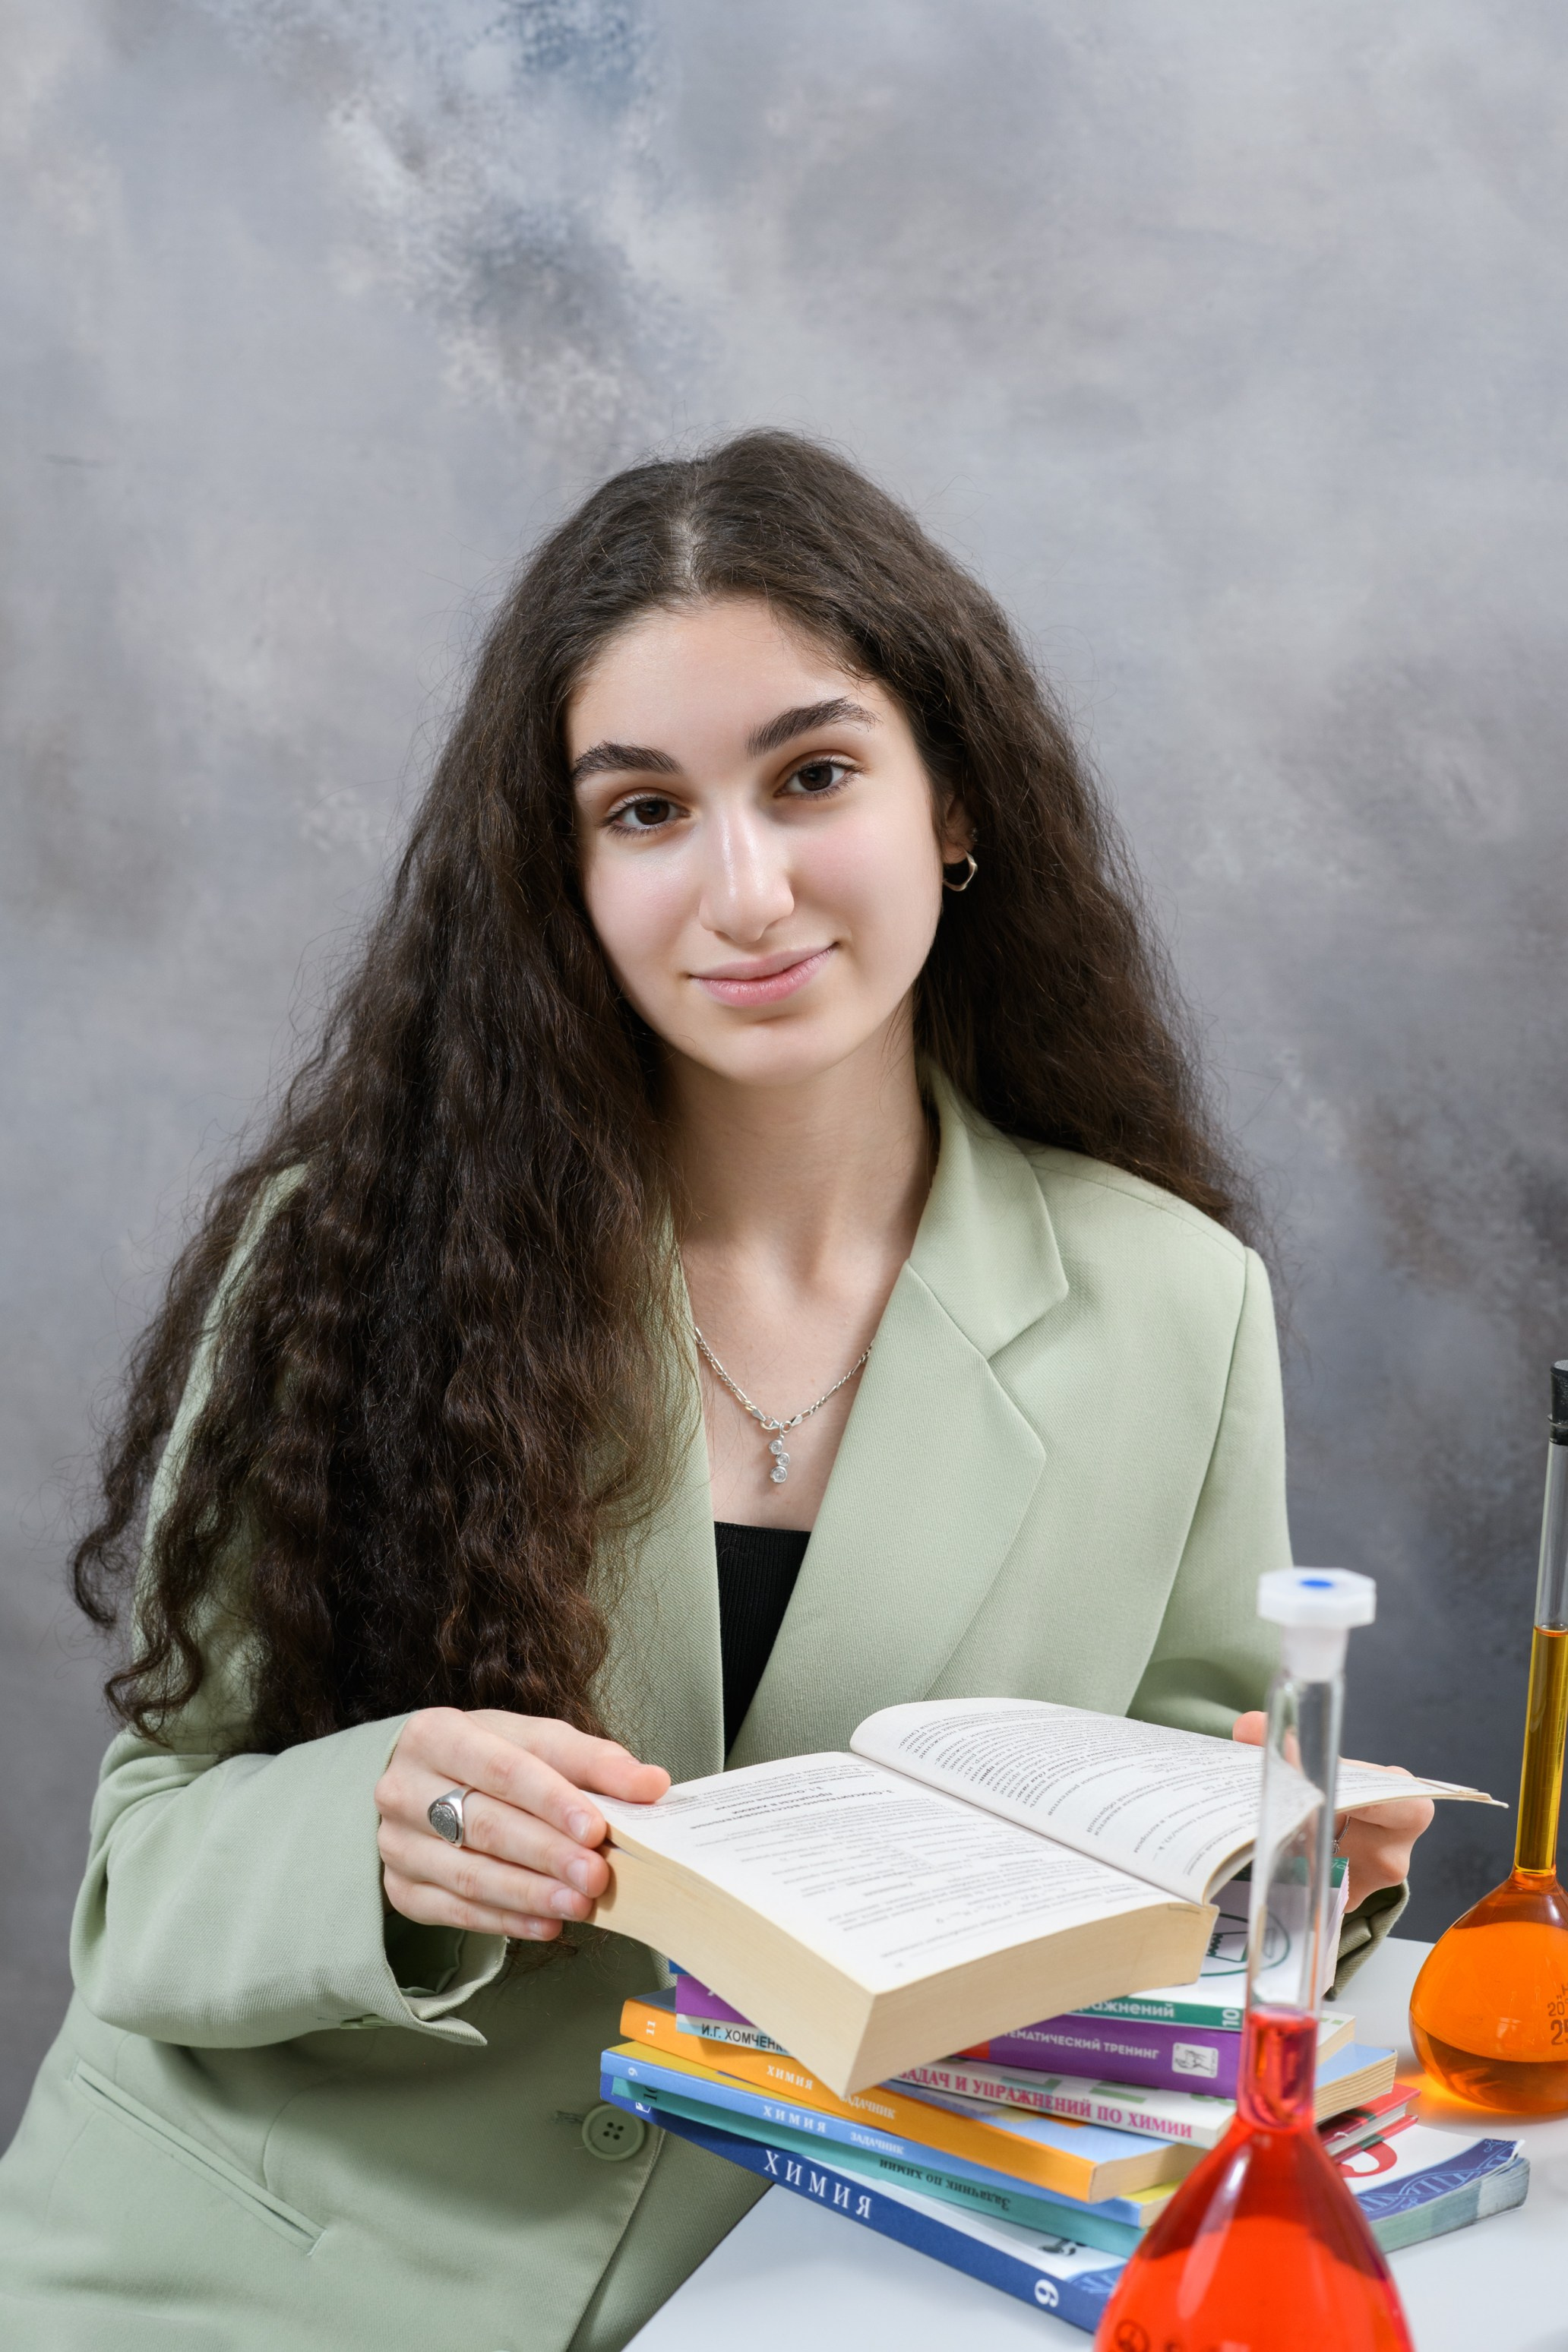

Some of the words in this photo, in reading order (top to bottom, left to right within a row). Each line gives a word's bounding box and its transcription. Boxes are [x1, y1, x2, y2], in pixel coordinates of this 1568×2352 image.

[918, 1729, 956, 1759] положение
[934, 1737, 966, 1765] уменьше-
[940, 1738, 978, 1769] положение
[969, 1750, 1006, 1781] состоянии
[978, 1765, 994, 1785] прин-
[991, 1767, 1014, 1792] только
[1029, 1770, 1046, 1783] (для
[999, 1771, 1020, 1795] другие
[1006, 1769, 1036, 1798] вещества
[1021, 1778, 1046, 1804] влияют
[1029, 1778, 1060, 1807] изменить
[776, 1792, 834, 1805] процессы
[1047, 1784, 1080, 1816] реагентов
[1086, 1800, 1116, 1832] обратной
[1093, 1805, 1121, 1836] является
[1133, 1822, 1159, 1854] котором
[1222, 2008, 1241, 2027] 10
[701, 2023, 721, 2038] И.Г.
[725, 2028, 786, 2052] ХОМЧЕНК
[1104, 2042, 1160, 2060] ТРЕНИНГ
[646, 2020, 656, 2036] 11
[767, 2065, 814, 2090] ХИМИЯ
[956, 2075, 968, 2092] И
[973, 2077, 1092, 2118] УПРАЖНЕНИЙ
[1097, 2106, 1123, 2125] ПО
[1127, 2109, 1192, 2139] ХИМИИ
[763, 2104, 827, 2133] ХИМИЯ
[851, 2132, 904, 2155] ЗАДАЧНИК
[879, 2158, 924, 2180] химии
[925, 2173, 942, 2186] по
[763, 2149, 872, 2220] ХИМИЯ
[946, 2179, 1011, 2211] Задачник
